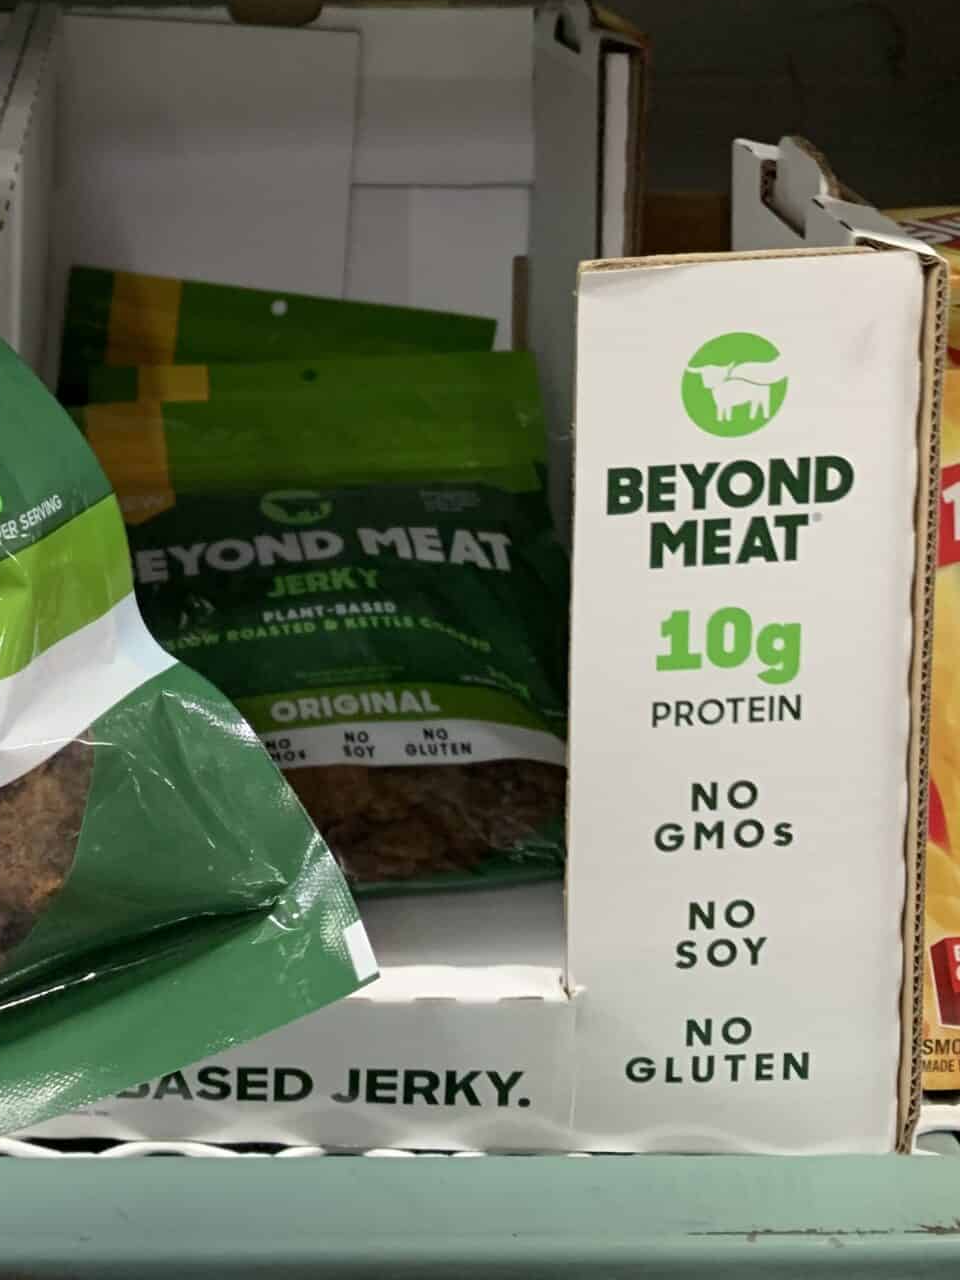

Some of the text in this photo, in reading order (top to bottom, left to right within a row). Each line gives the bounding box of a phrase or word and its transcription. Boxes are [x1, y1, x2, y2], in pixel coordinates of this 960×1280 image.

[606, 455, 855, 516] BEYOND
[20, 494, 63, 531] SERVING
[356, 527, 513, 572] MEAT
[649, 513, 810, 569] MEAT
[267, 566, 379, 599] JERKY
[263, 600, 397, 622] PLANT-BASED
[655, 606, 802, 685] 10g
[270, 689, 441, 722] ORIGINAL
[652, 694, 803, 728] PROTEIN
[344, 730, 369, 743] NO
[405, 742, 472, 757] GLUTEN
[422, 727, 448, 741] NO
[691, 780, 759, 812] NO
[654, 818, 794, 852] GMOs
[688, 899, 755, 930] NO
[675, 936, 768, 969] SOY
[685, 1016, 752, 1047] NO
[625, 1051, 810, 1084] GLUTEN
[330, 1068, 532, 1108] JERKY.
